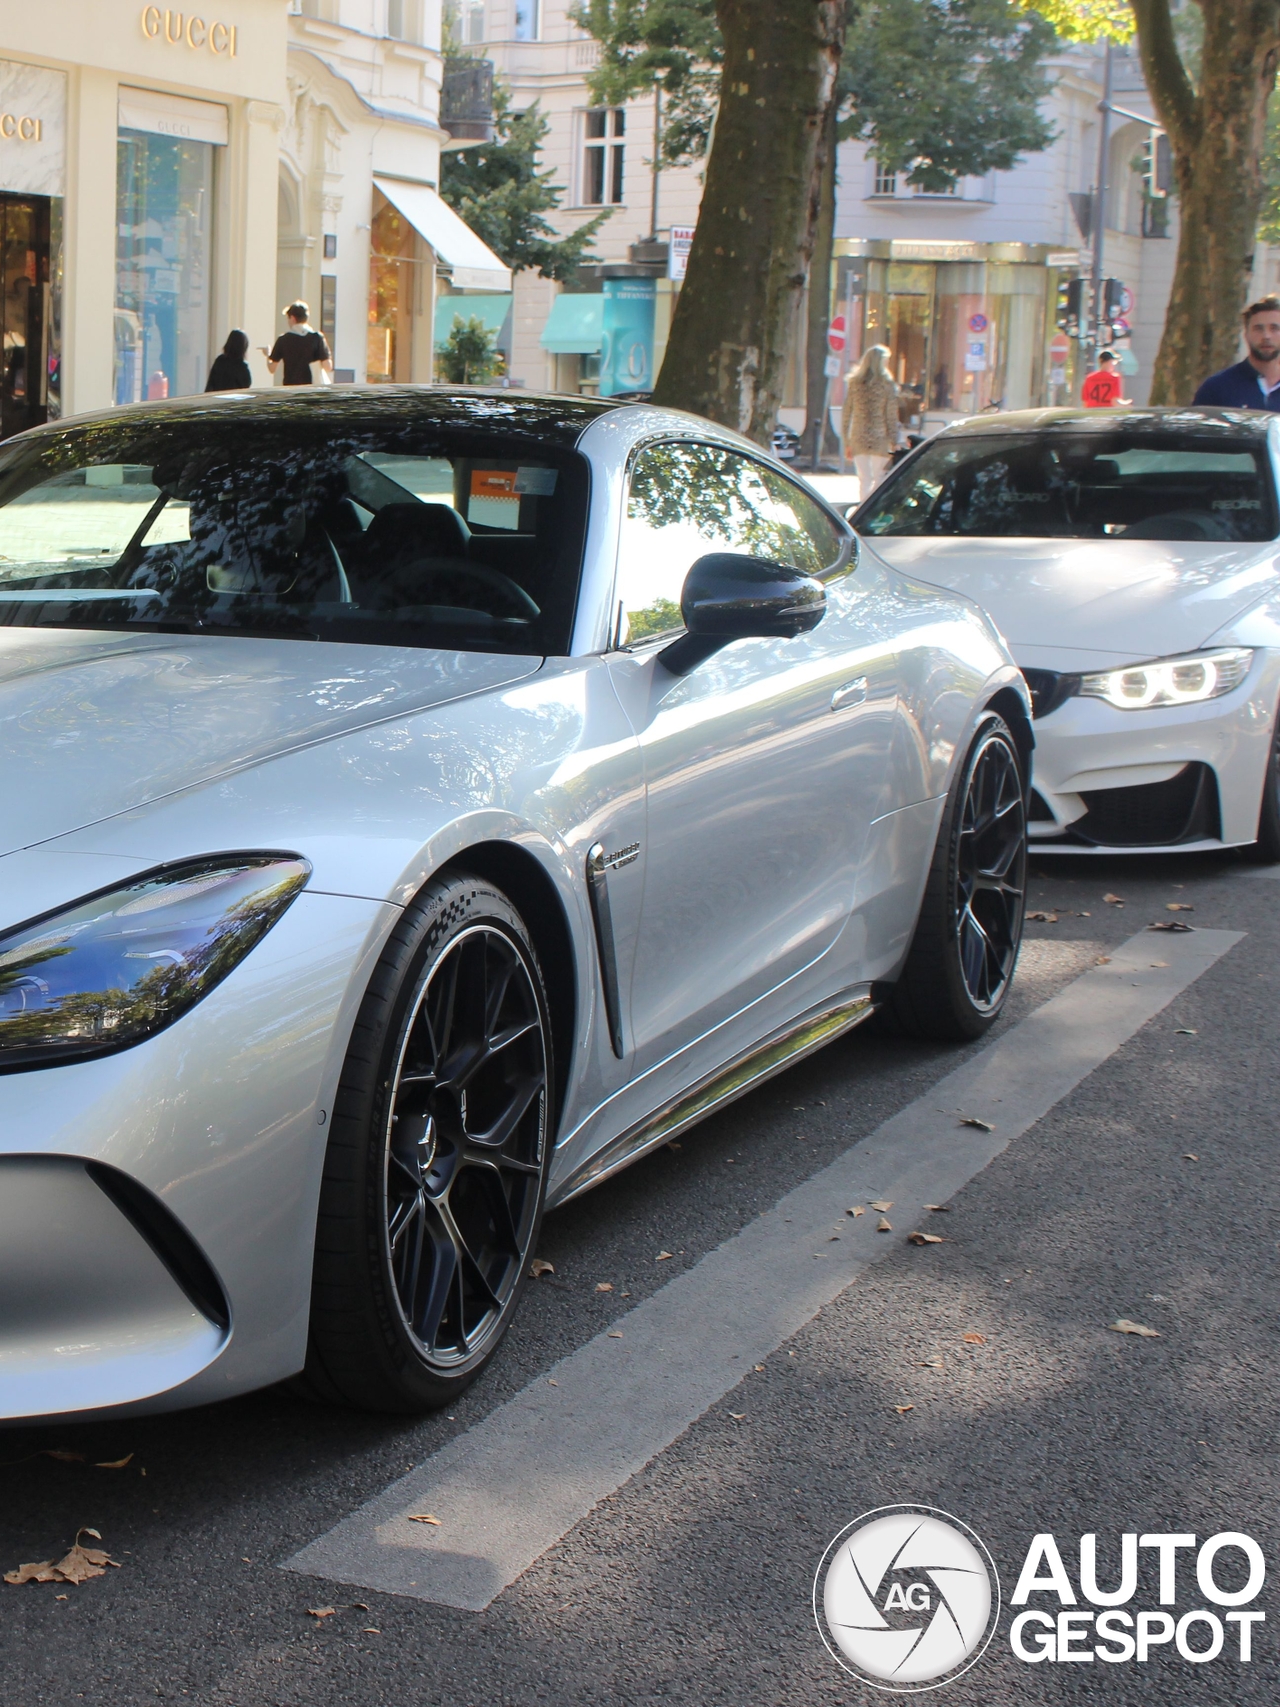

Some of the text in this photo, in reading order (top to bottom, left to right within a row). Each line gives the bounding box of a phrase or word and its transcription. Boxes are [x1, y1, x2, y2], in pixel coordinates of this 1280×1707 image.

[141, 5, 237, 57] GUCCI
[158, 120, 191, 136] GUCCI
[1090, 383, 1111, 403] 42
[1212, 501, 1261, 509] RECAR
